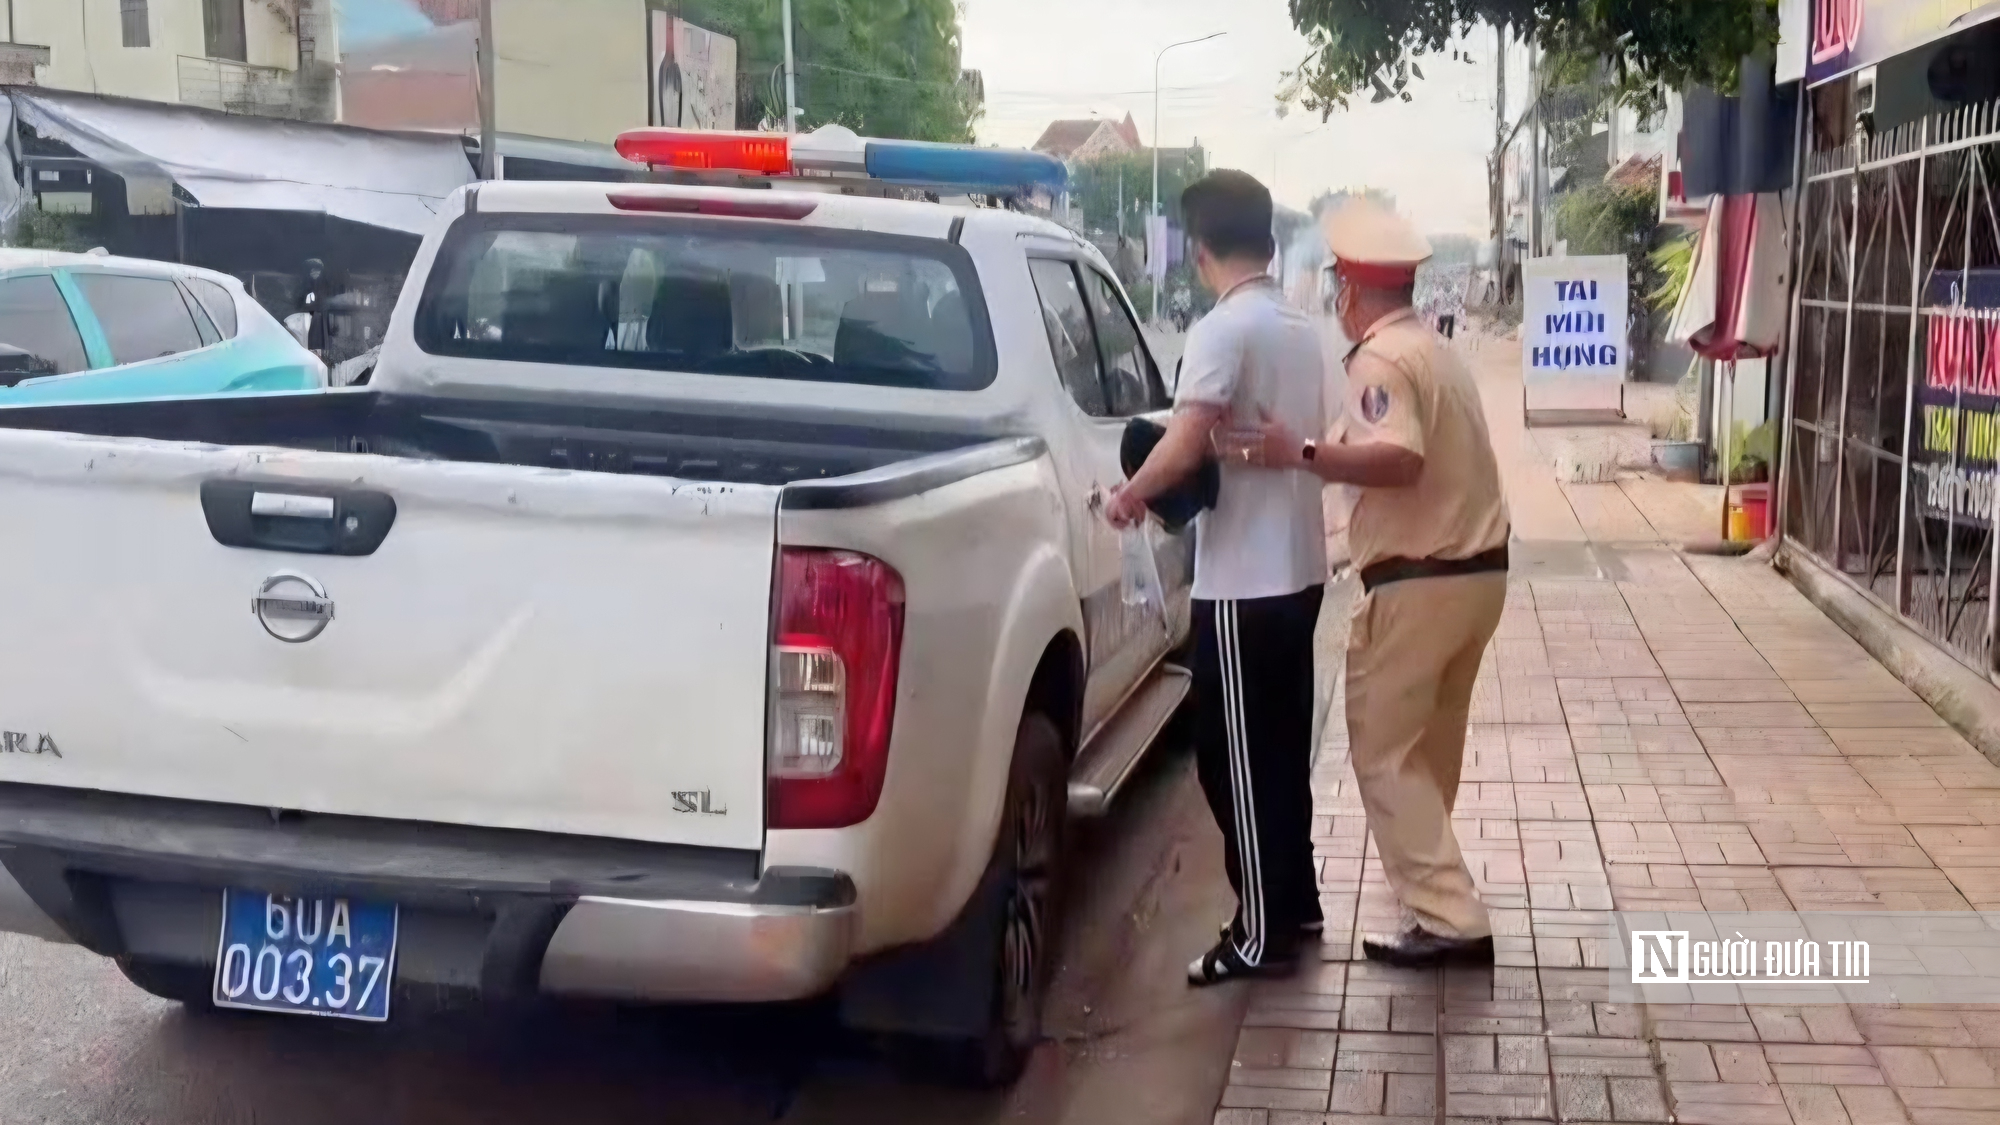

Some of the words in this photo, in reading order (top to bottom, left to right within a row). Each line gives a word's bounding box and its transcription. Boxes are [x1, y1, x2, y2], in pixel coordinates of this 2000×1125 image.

[1554, 280, 1597, 301] TAI
[0, 731, 62, 758] RA
[671, 787, 727, 815] SL
[222, 943, 385, 1010] 003.37
